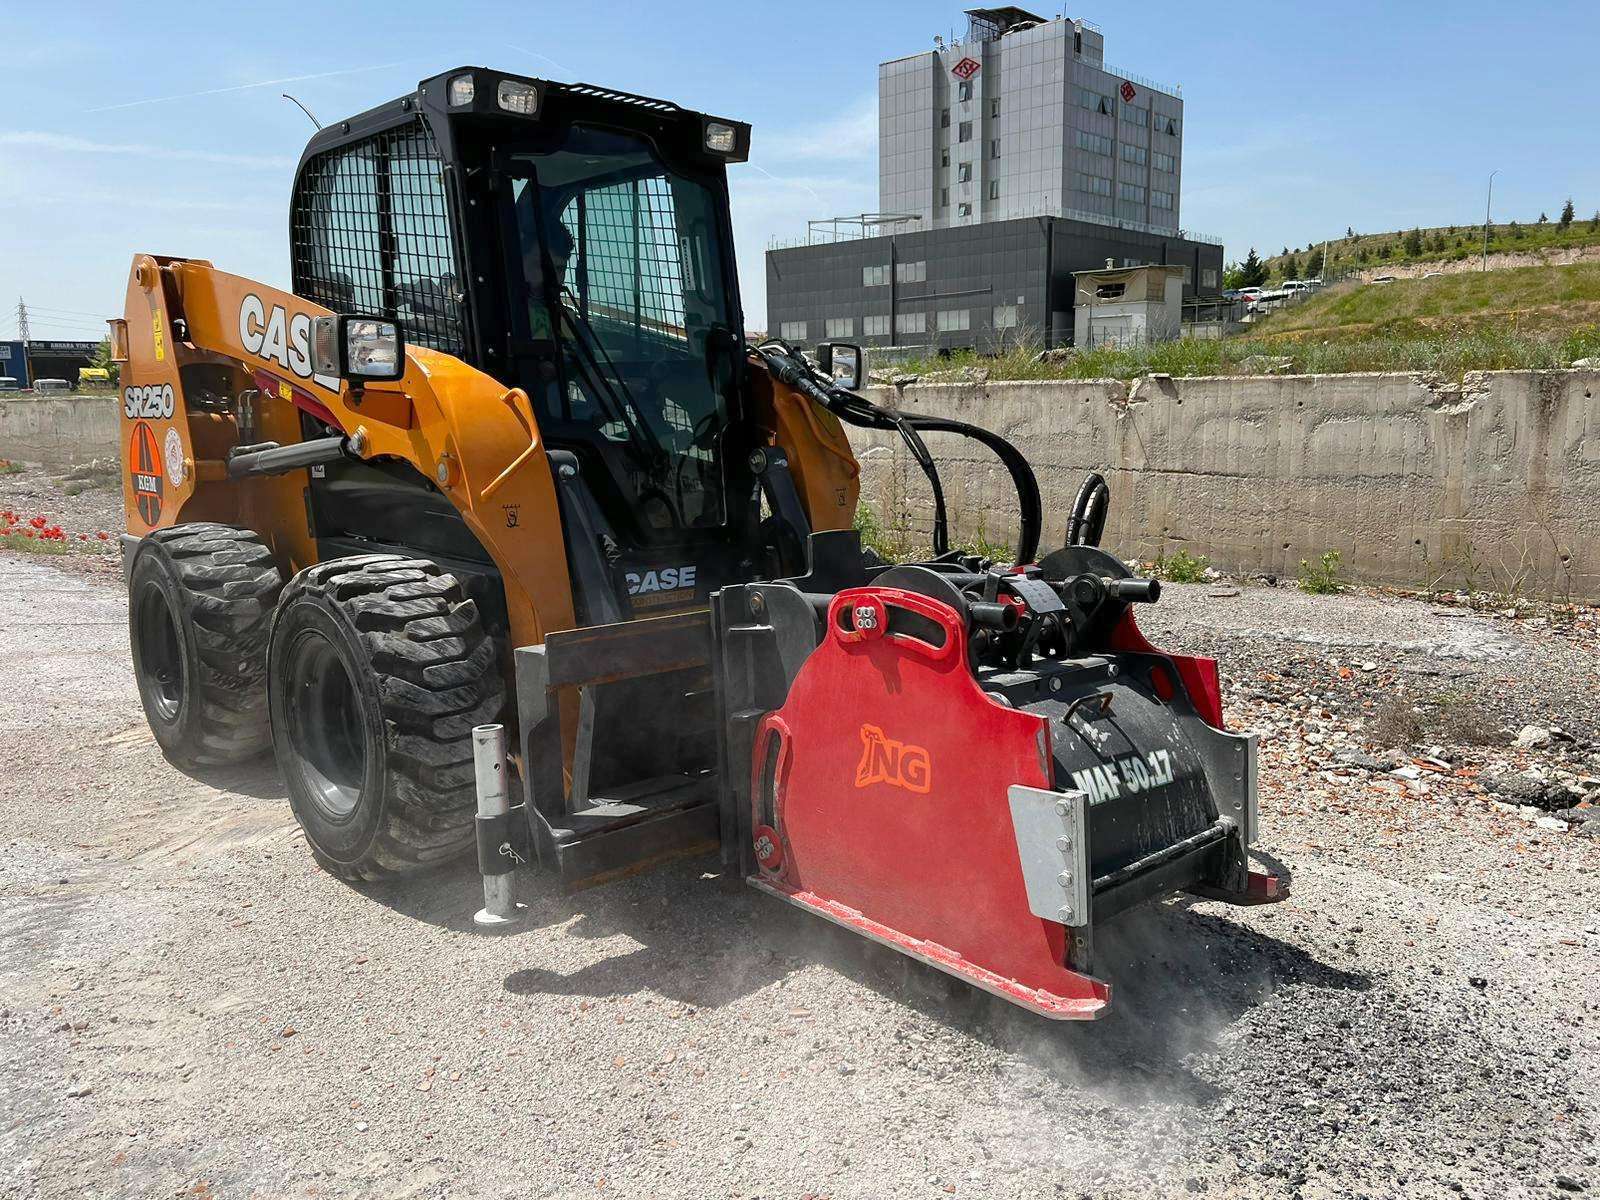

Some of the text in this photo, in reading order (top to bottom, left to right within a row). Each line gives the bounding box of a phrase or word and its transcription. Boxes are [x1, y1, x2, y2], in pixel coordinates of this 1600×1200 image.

[239, 293, 340, 394] CAS
[124, 383, 174, 419] SR250
[138, 475, 157, 492] KGM
[625, 566, 697, 595] CASE
[1071, 749, 1174, 807] MAF 50.17
